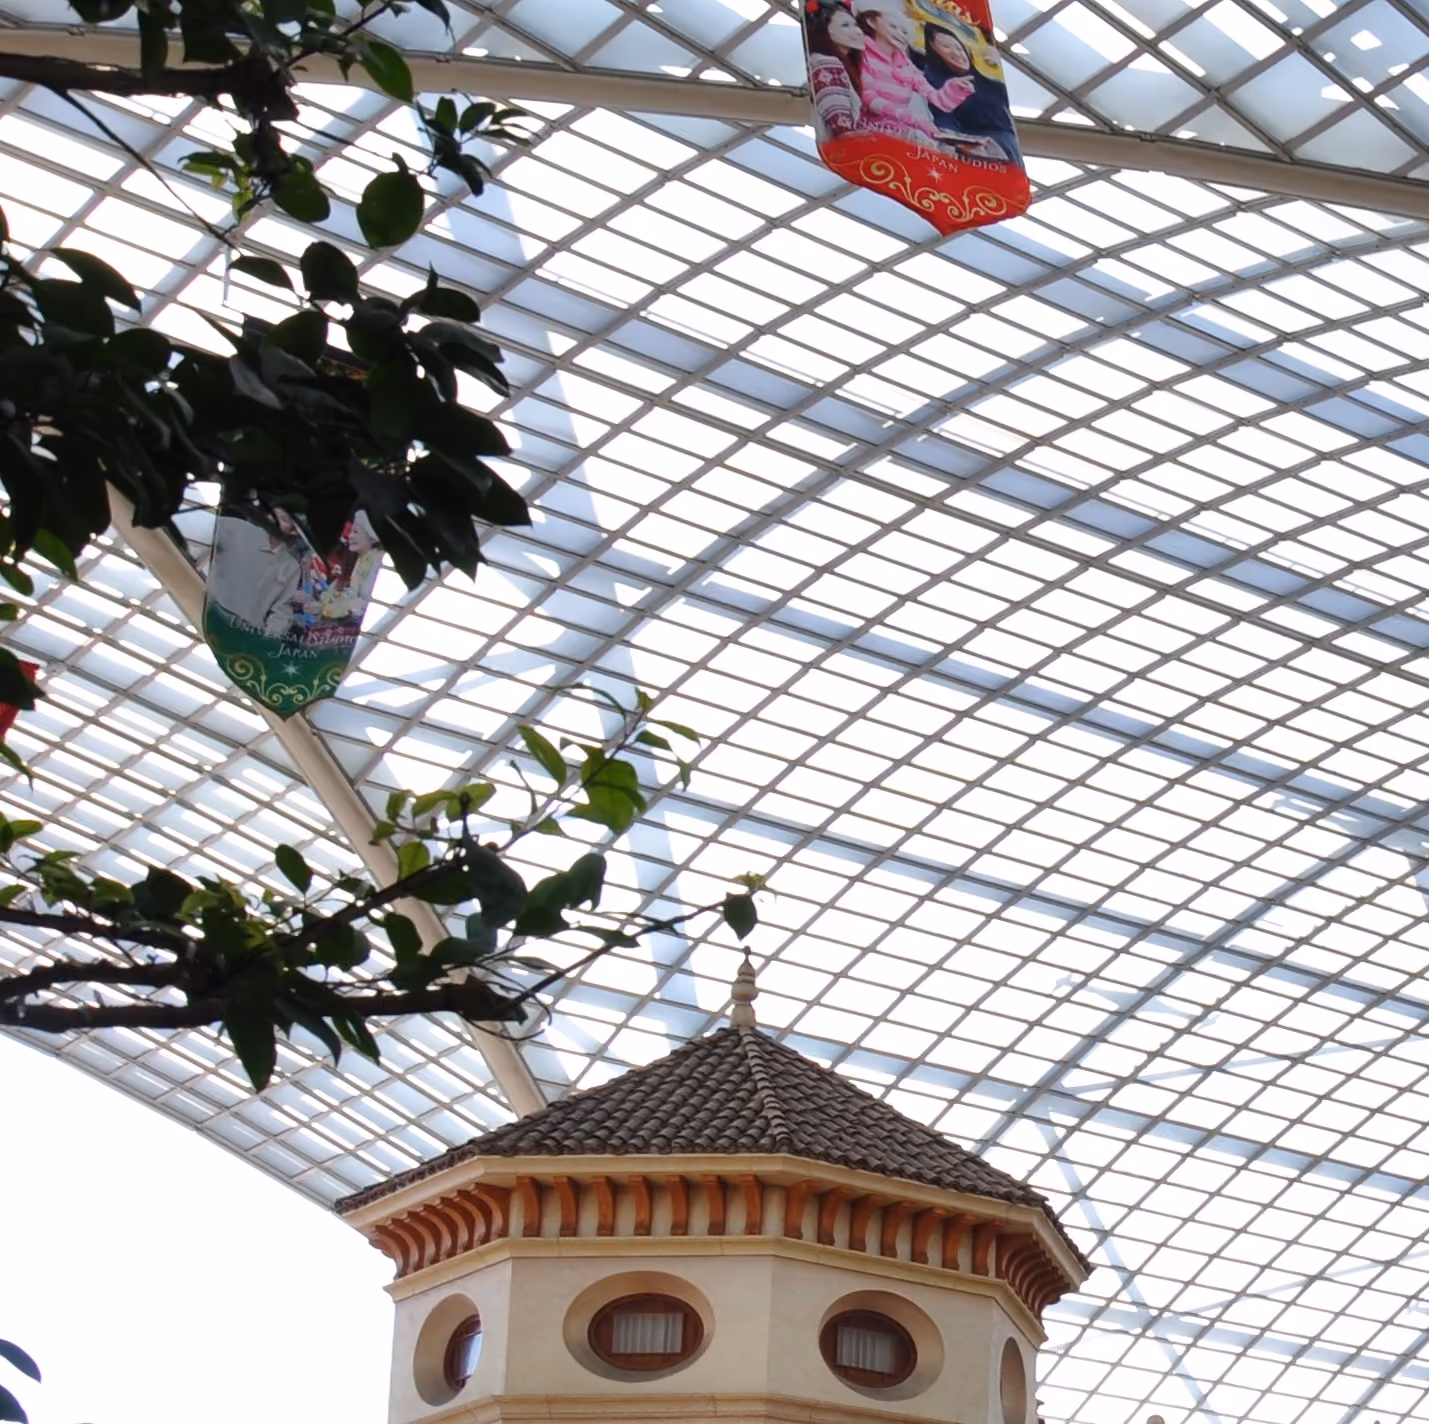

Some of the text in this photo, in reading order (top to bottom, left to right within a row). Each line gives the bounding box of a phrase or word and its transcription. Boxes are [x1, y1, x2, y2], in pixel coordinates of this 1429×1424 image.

[906, 146, 958, 173] JAPAN
[950, 152, 1007, 174] TUDIOS
[268, 644, 317, 658] JAPAN
